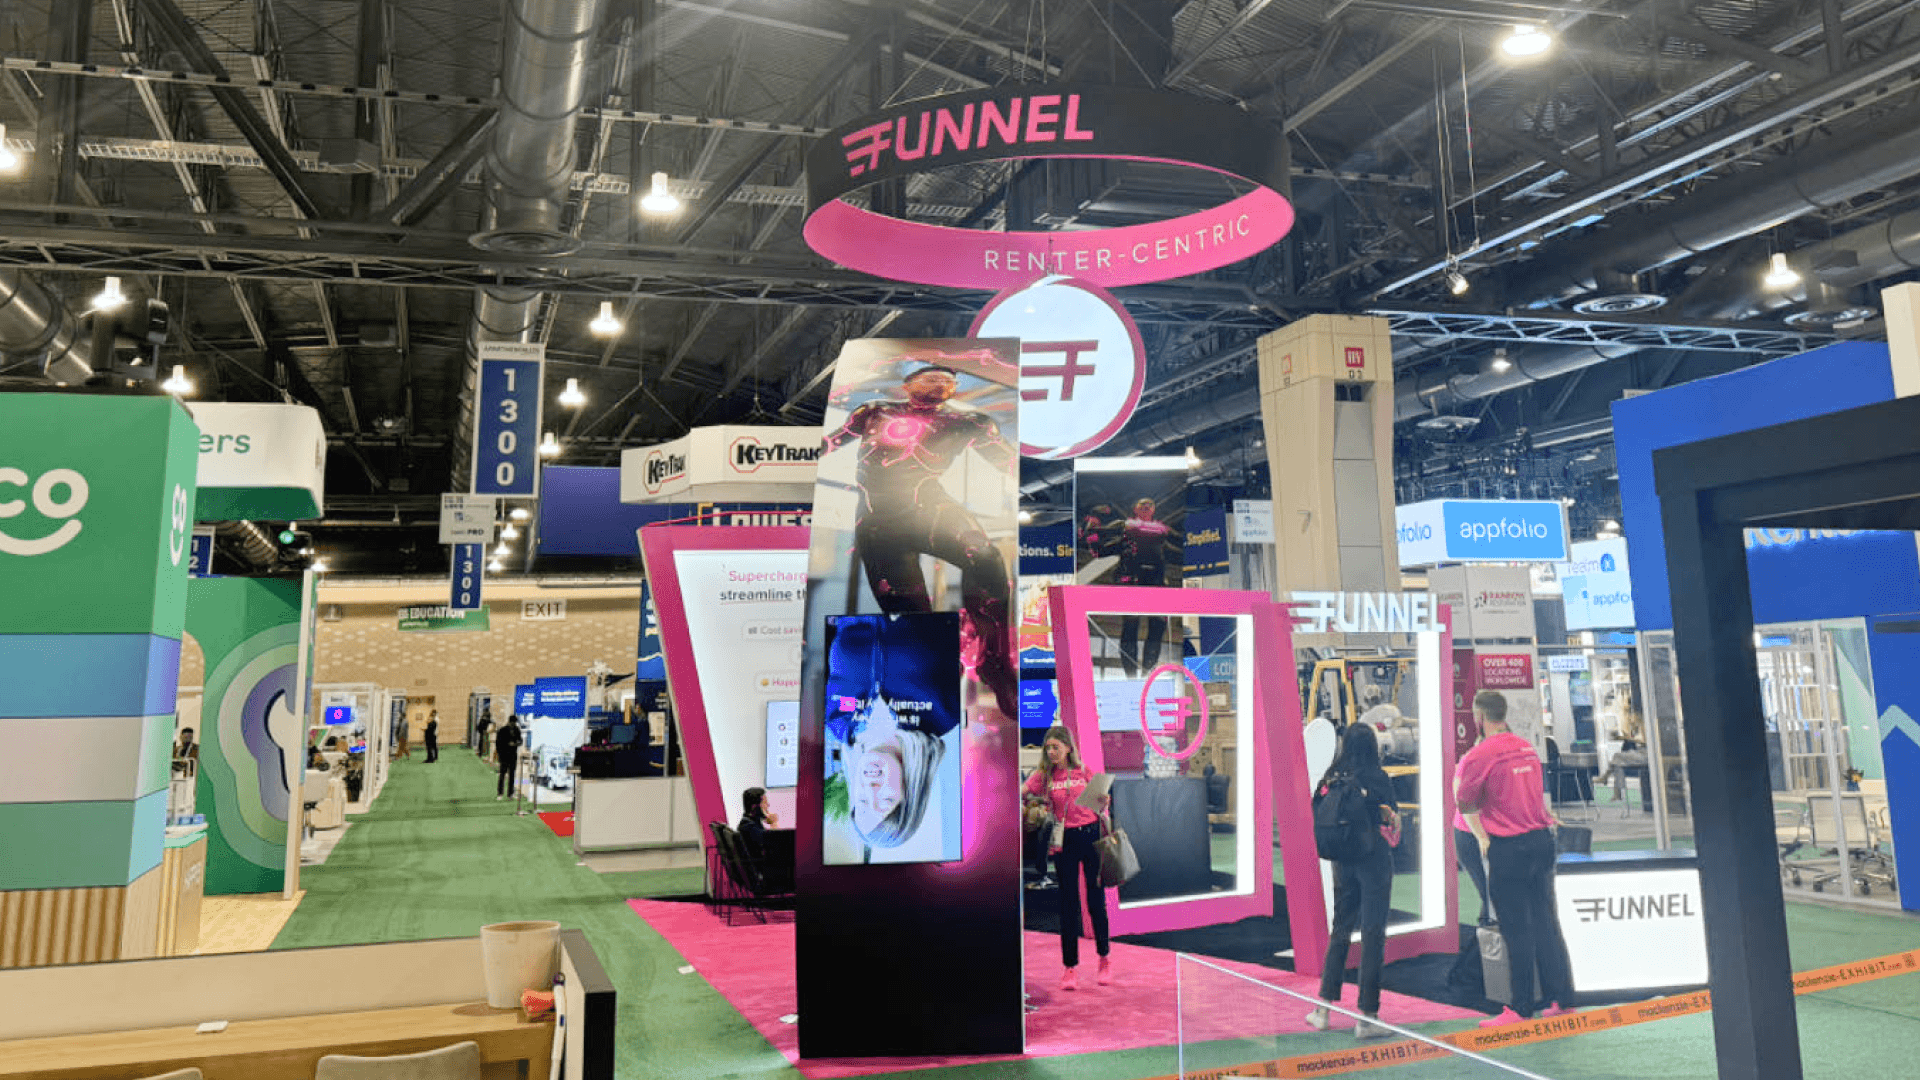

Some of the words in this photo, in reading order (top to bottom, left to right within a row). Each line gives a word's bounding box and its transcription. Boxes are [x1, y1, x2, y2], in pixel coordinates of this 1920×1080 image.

[842, 94, 1094, 177] FUNNEL
[984, 214, 1251, 271] RENTER-CENTRIC
[1459, 517, 1548, 543] appfolio
[720, 588, 793, 601] streamline
[525, 602, 562, 617] EXIT
[1284, 590, 1446, 633] FUNNEL
[1572, 893, 1695, 922] FUNNEL
